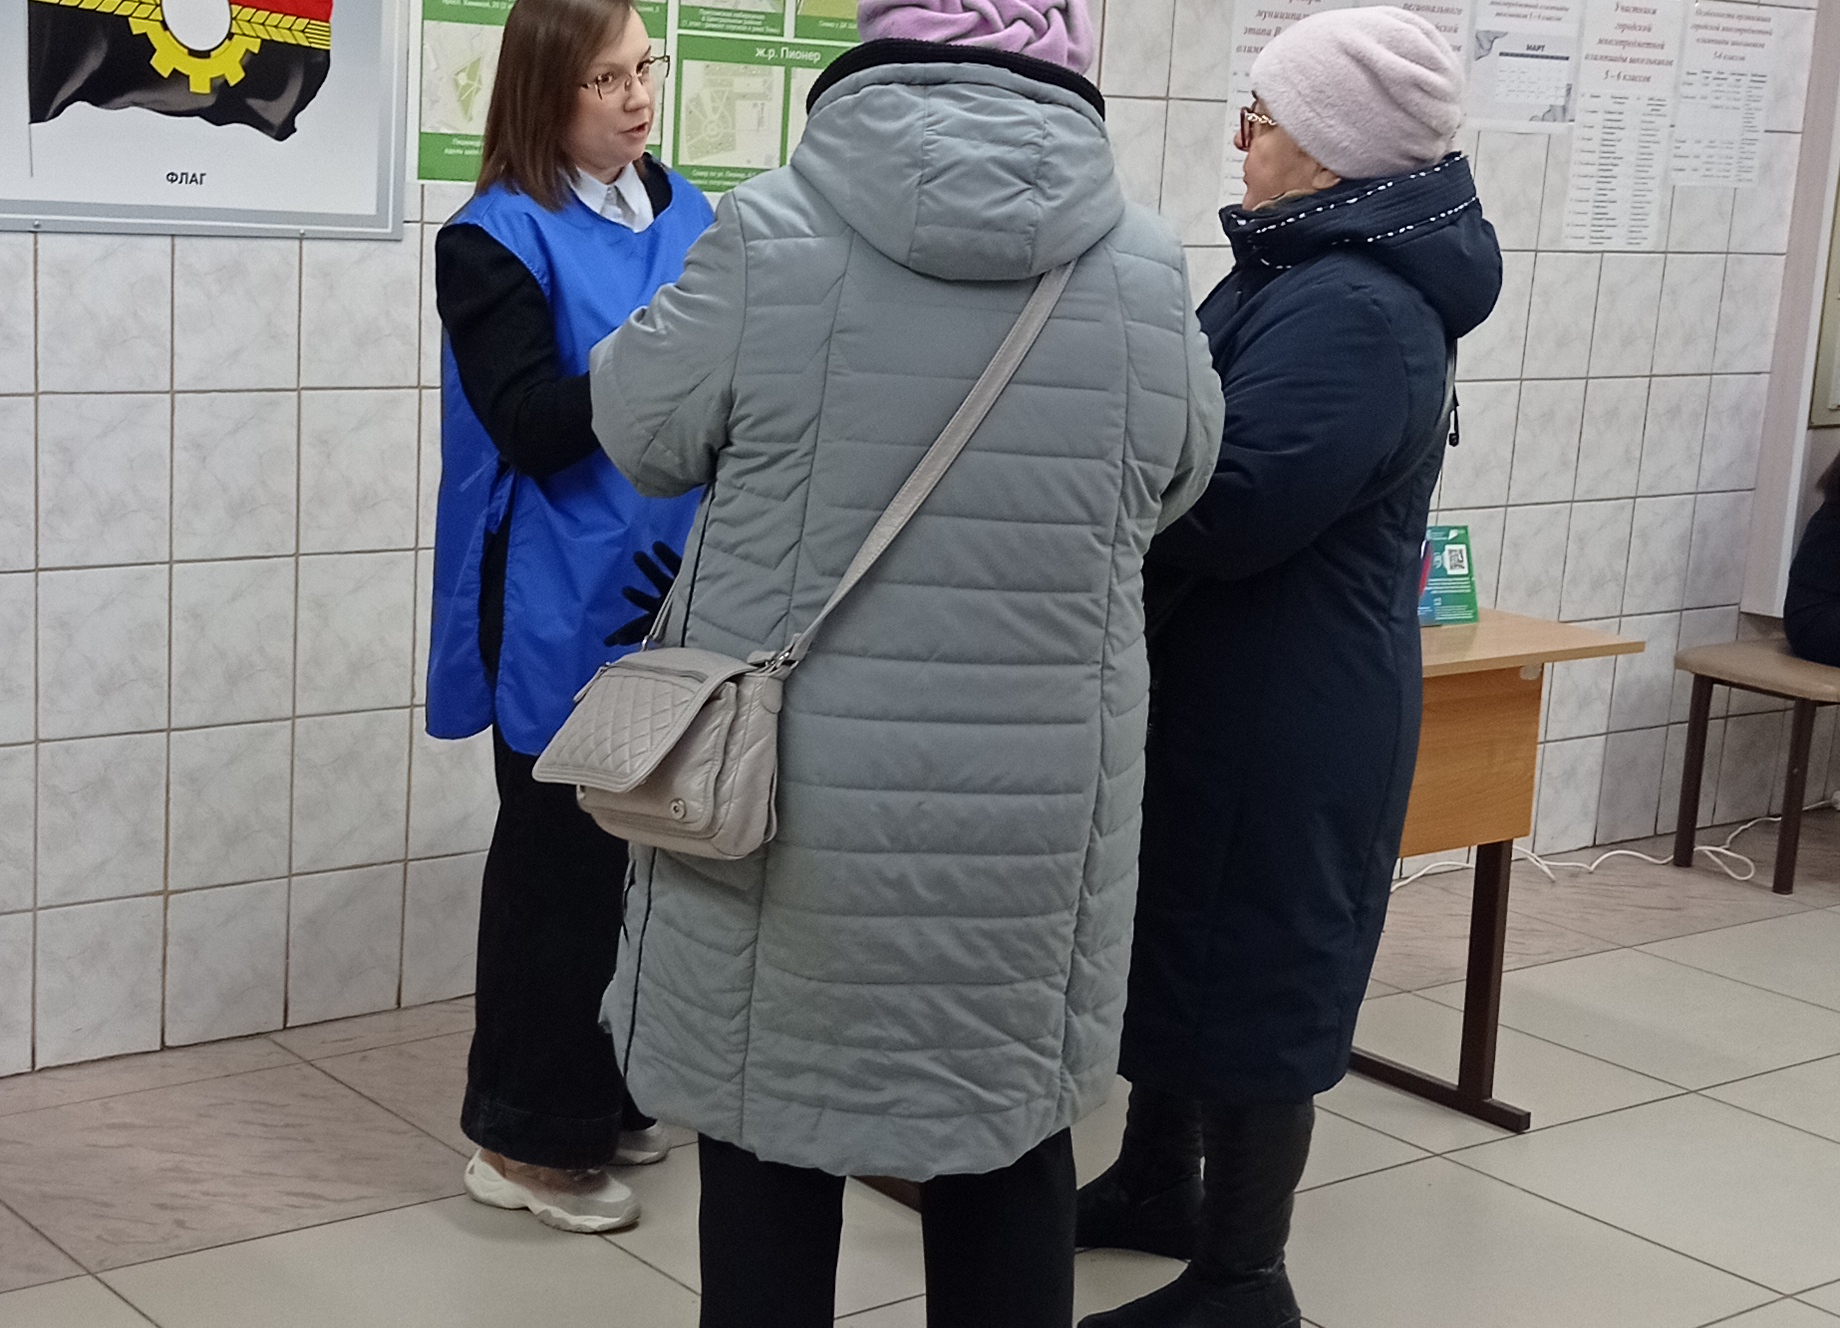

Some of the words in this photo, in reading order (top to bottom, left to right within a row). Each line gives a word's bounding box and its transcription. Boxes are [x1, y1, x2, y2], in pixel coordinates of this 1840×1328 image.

[755, 47, 777, 62] ж.р.
[780, 47, 822, 65] Пионер
[166, 171, 207, 186] ФЛАГ
